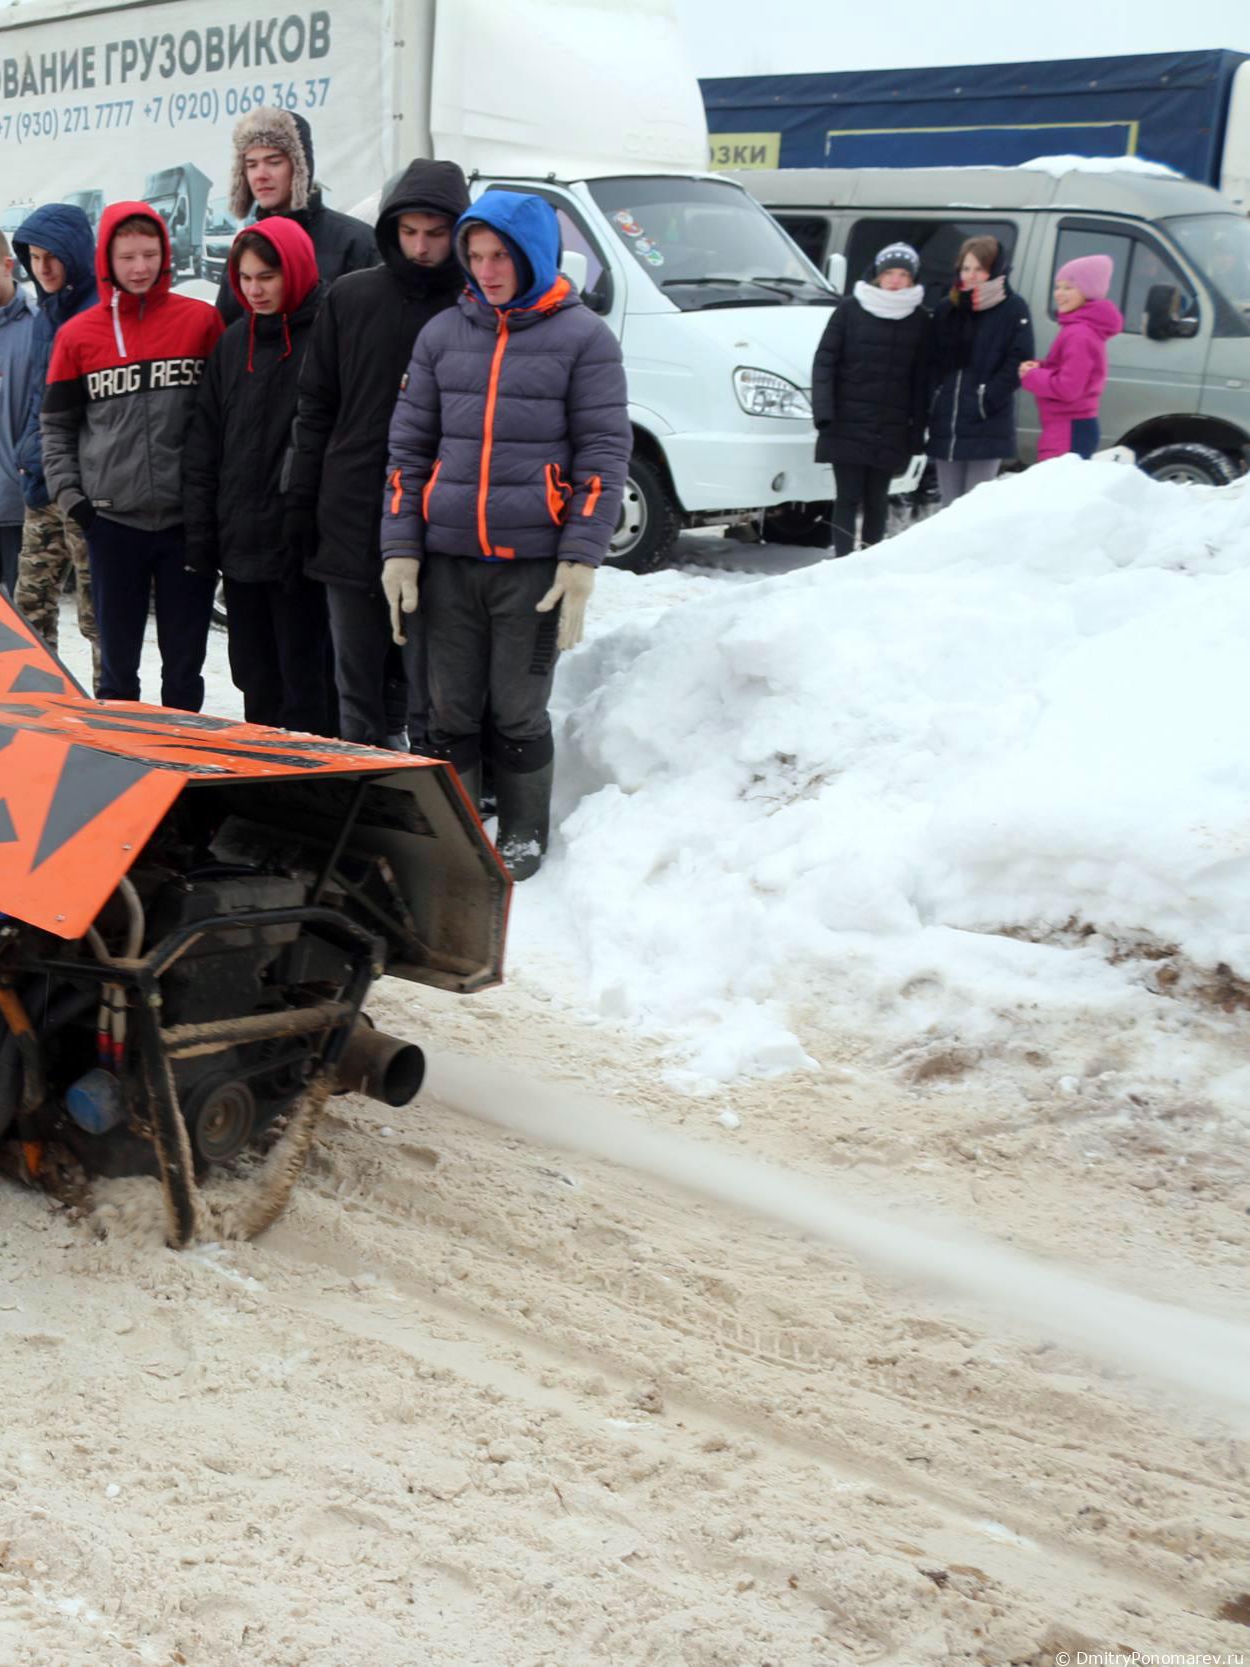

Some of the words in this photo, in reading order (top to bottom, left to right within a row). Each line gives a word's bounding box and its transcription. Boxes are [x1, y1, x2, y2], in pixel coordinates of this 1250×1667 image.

[105, 10, 332, 86] ГРУЗОВИКОВ
[15, 108, 59, 145] (930)
[63, 105, 91, 133] 271
[94, 100, 135, 130] 7777
[143, 97, 163, 124] +7
[167, 88, 219, 129] (920)
[225, 85, 266, 117] 069
[271, 82, 299, 110] 36
[304, 77, 332, 108] 37
